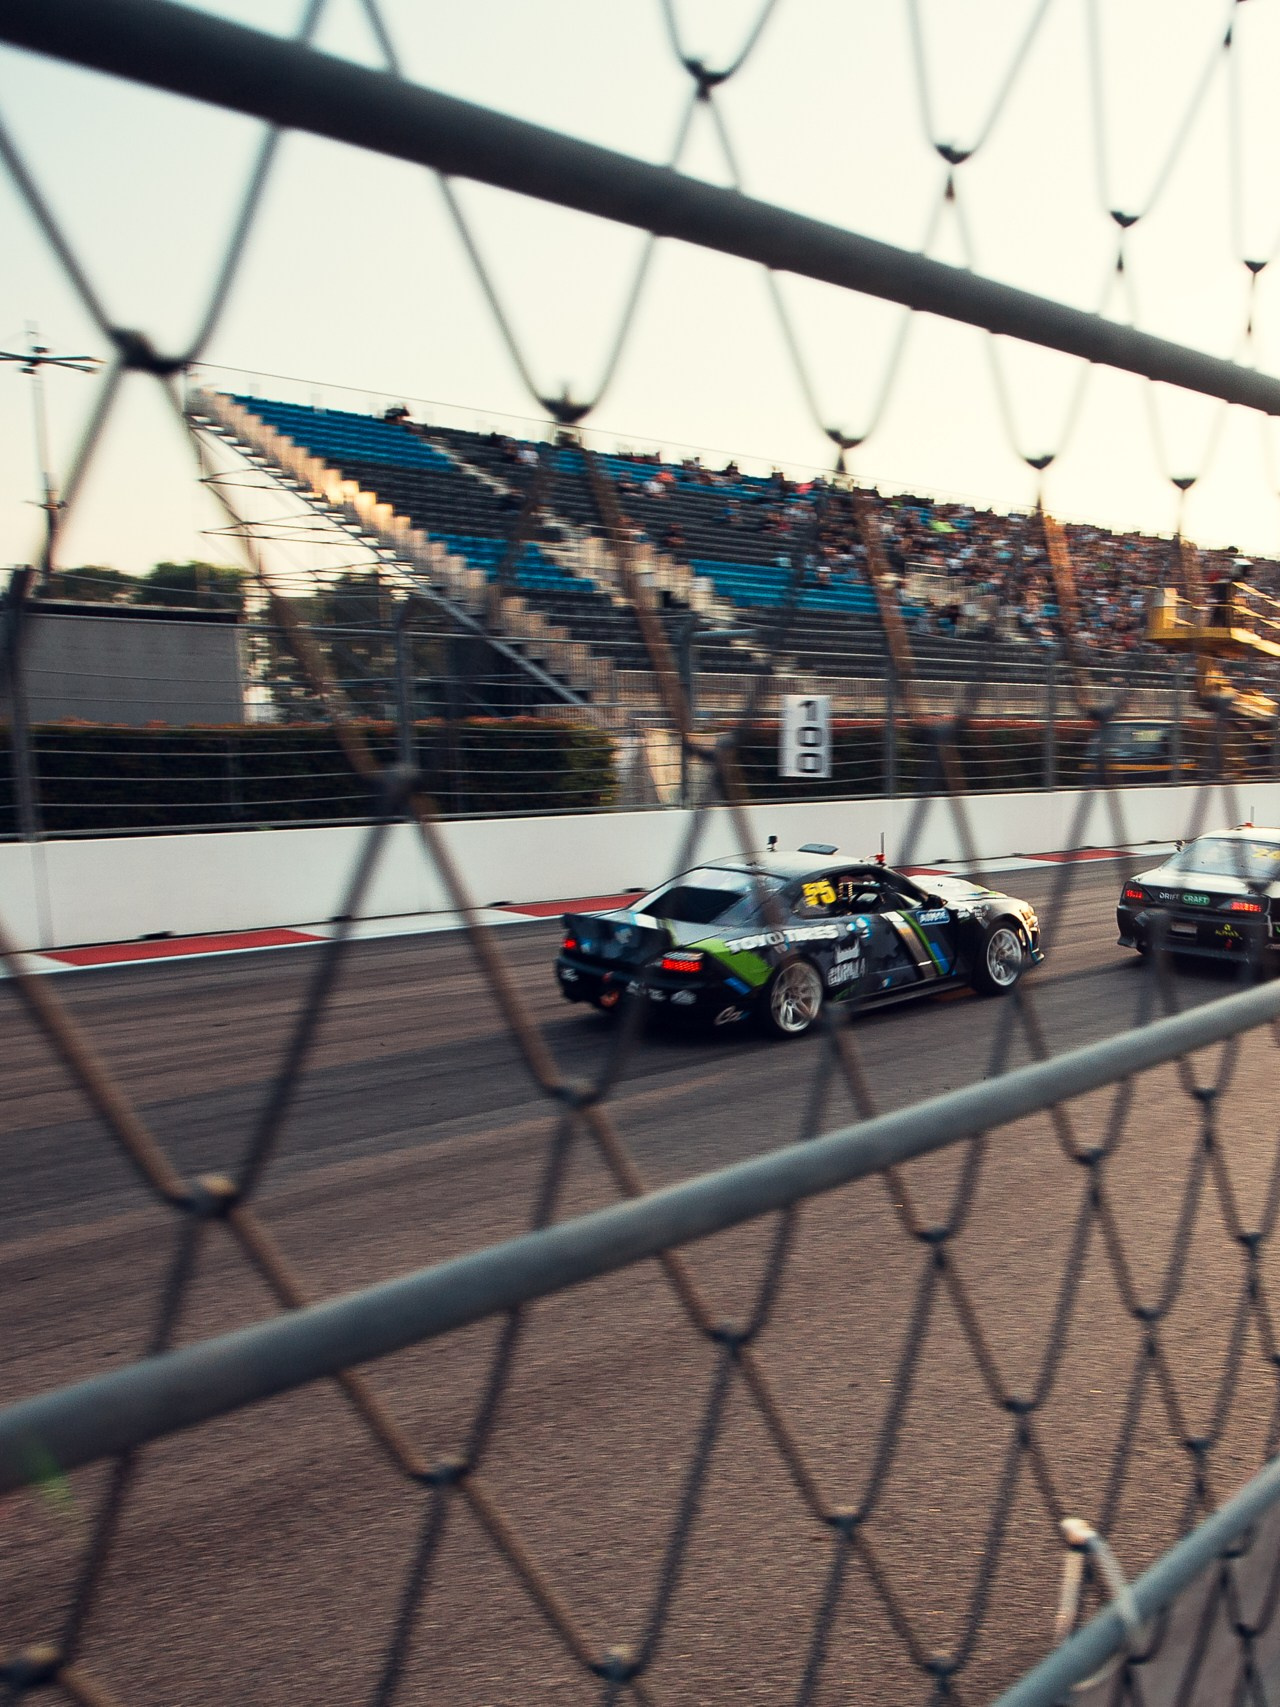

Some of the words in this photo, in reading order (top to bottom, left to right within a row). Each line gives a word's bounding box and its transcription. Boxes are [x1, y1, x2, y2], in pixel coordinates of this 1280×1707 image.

[797, 700, 822, 773] 100
[801, 880, 837, 906] 55
[1159, 891, 1180, 900] DRIFT
[1183, 893, 1209, 904] CRAFT
[725, 931, 785, 954] TOYO
[783, 924, 839, 942] TIRES
